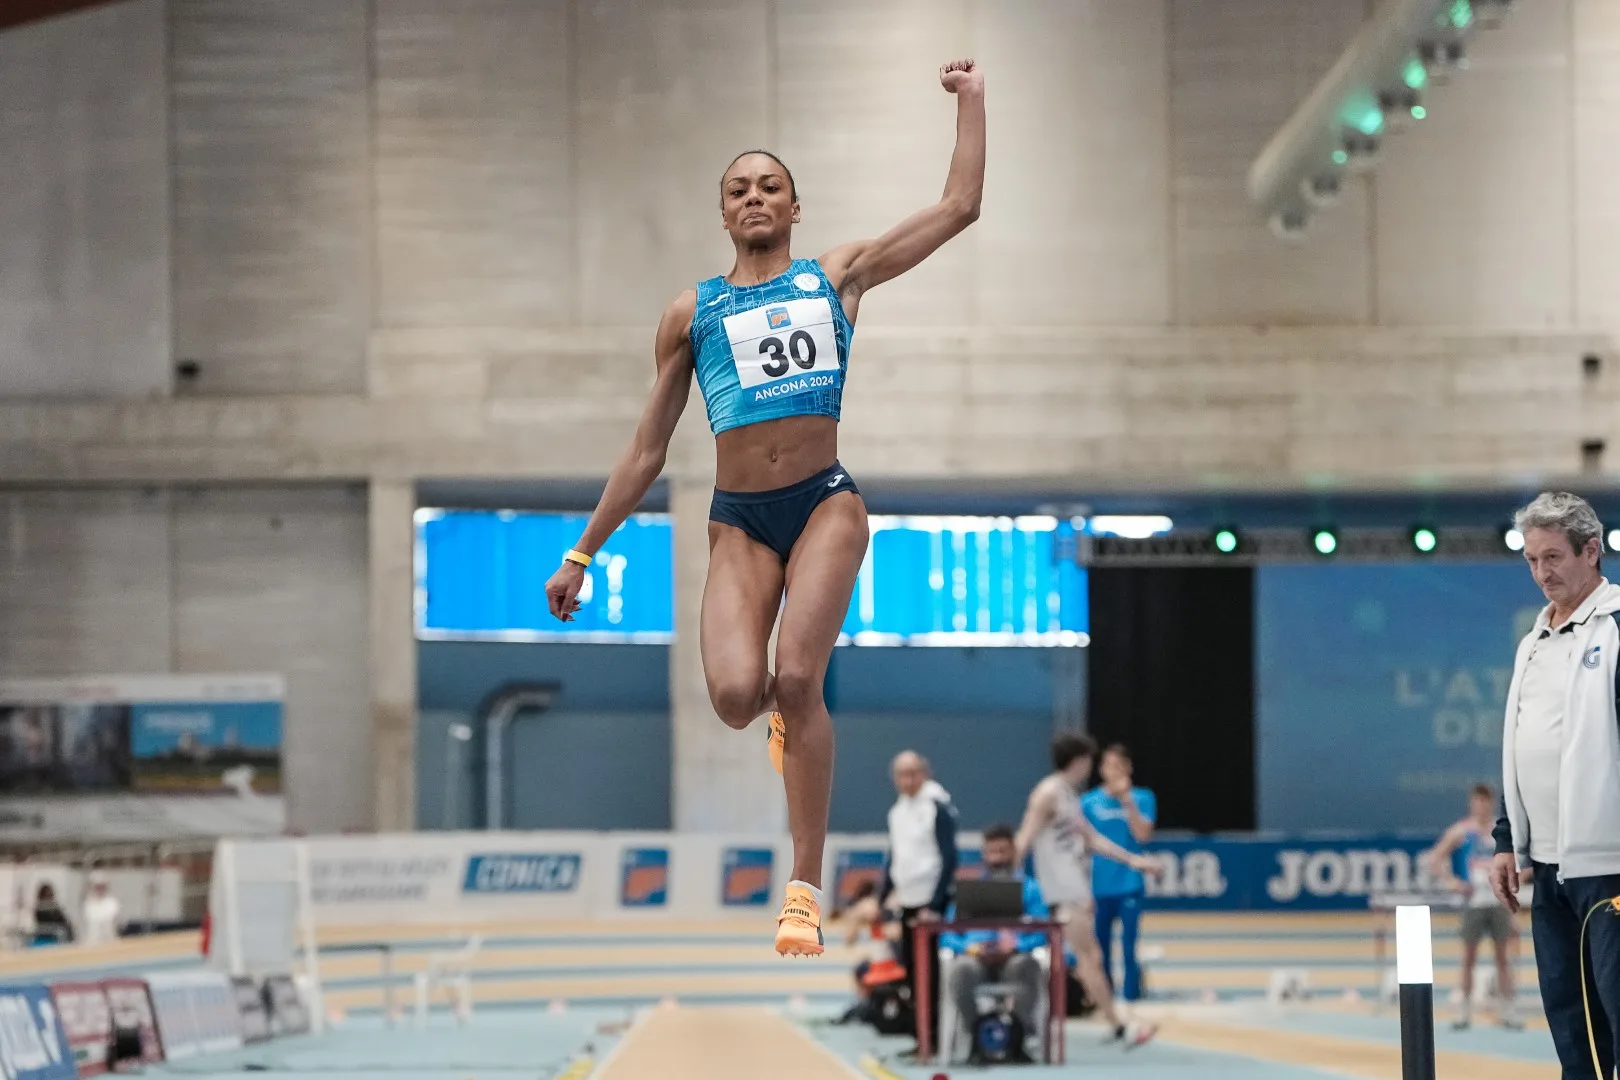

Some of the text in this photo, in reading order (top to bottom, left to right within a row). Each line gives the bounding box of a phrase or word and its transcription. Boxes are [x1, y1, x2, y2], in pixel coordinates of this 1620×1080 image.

[759, 330, 816, 378] 30
[755, 375, 834, 401] ANCONA 2024
[784, 907, 810, 918] PUMA
